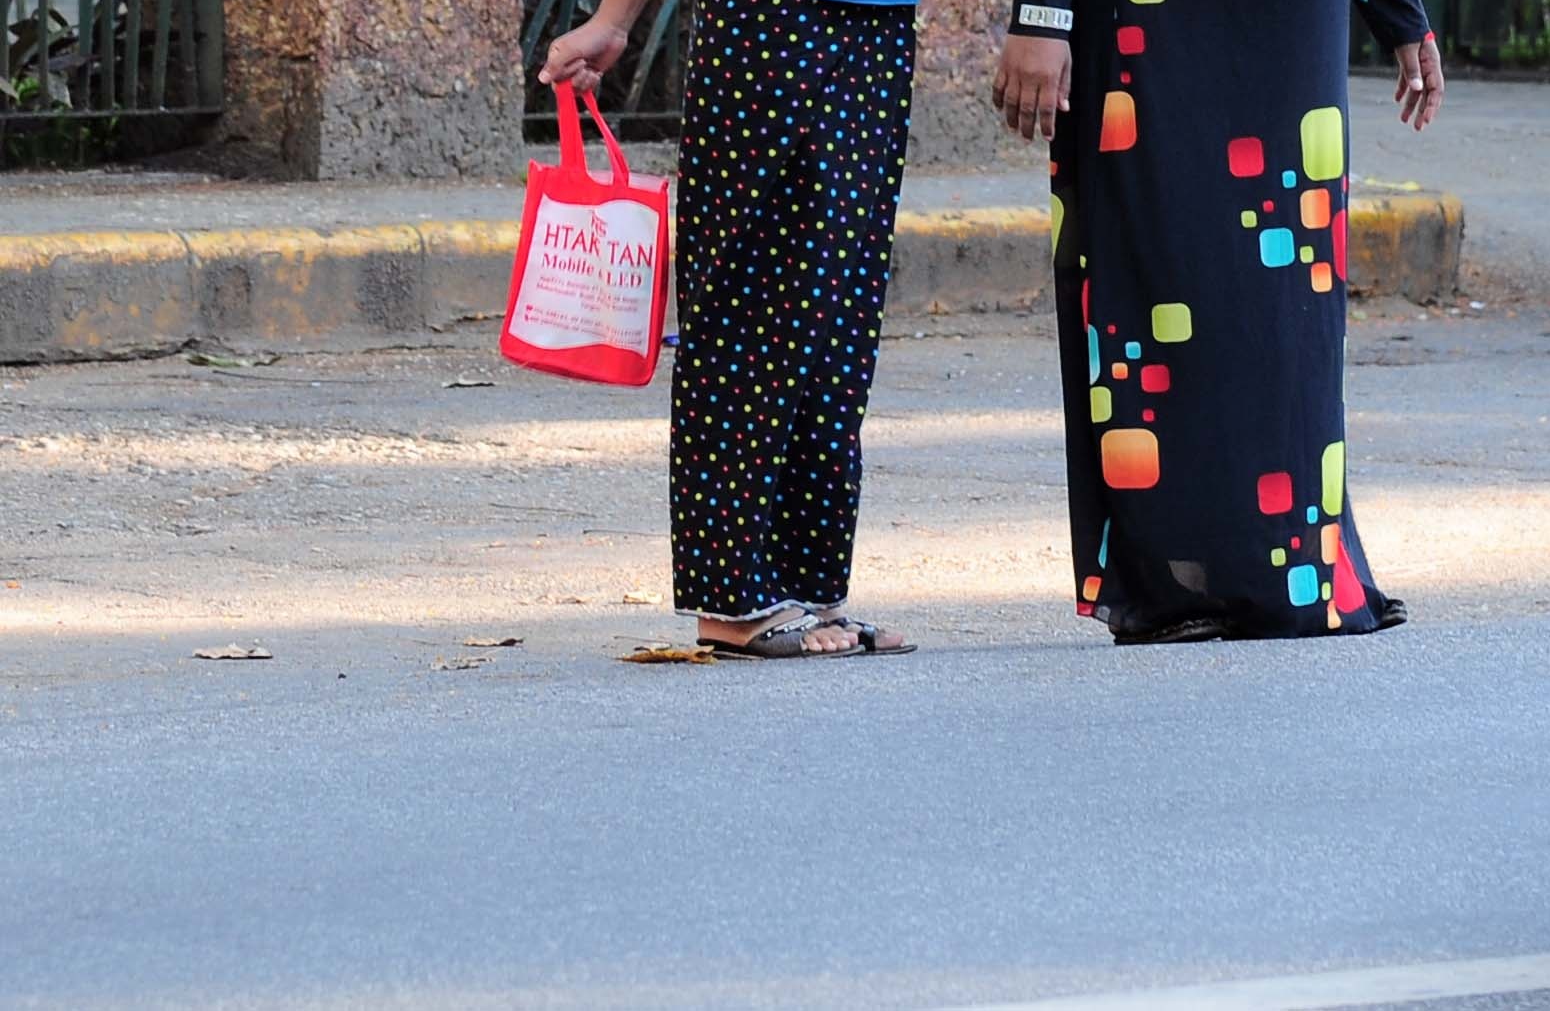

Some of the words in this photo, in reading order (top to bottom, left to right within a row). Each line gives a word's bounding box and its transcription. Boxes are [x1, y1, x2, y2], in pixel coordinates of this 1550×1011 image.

[544, 222, 600, 257] HTAK
[607, 238, 654, 268] TAN
[542, 252, 595, 276] Mobile
